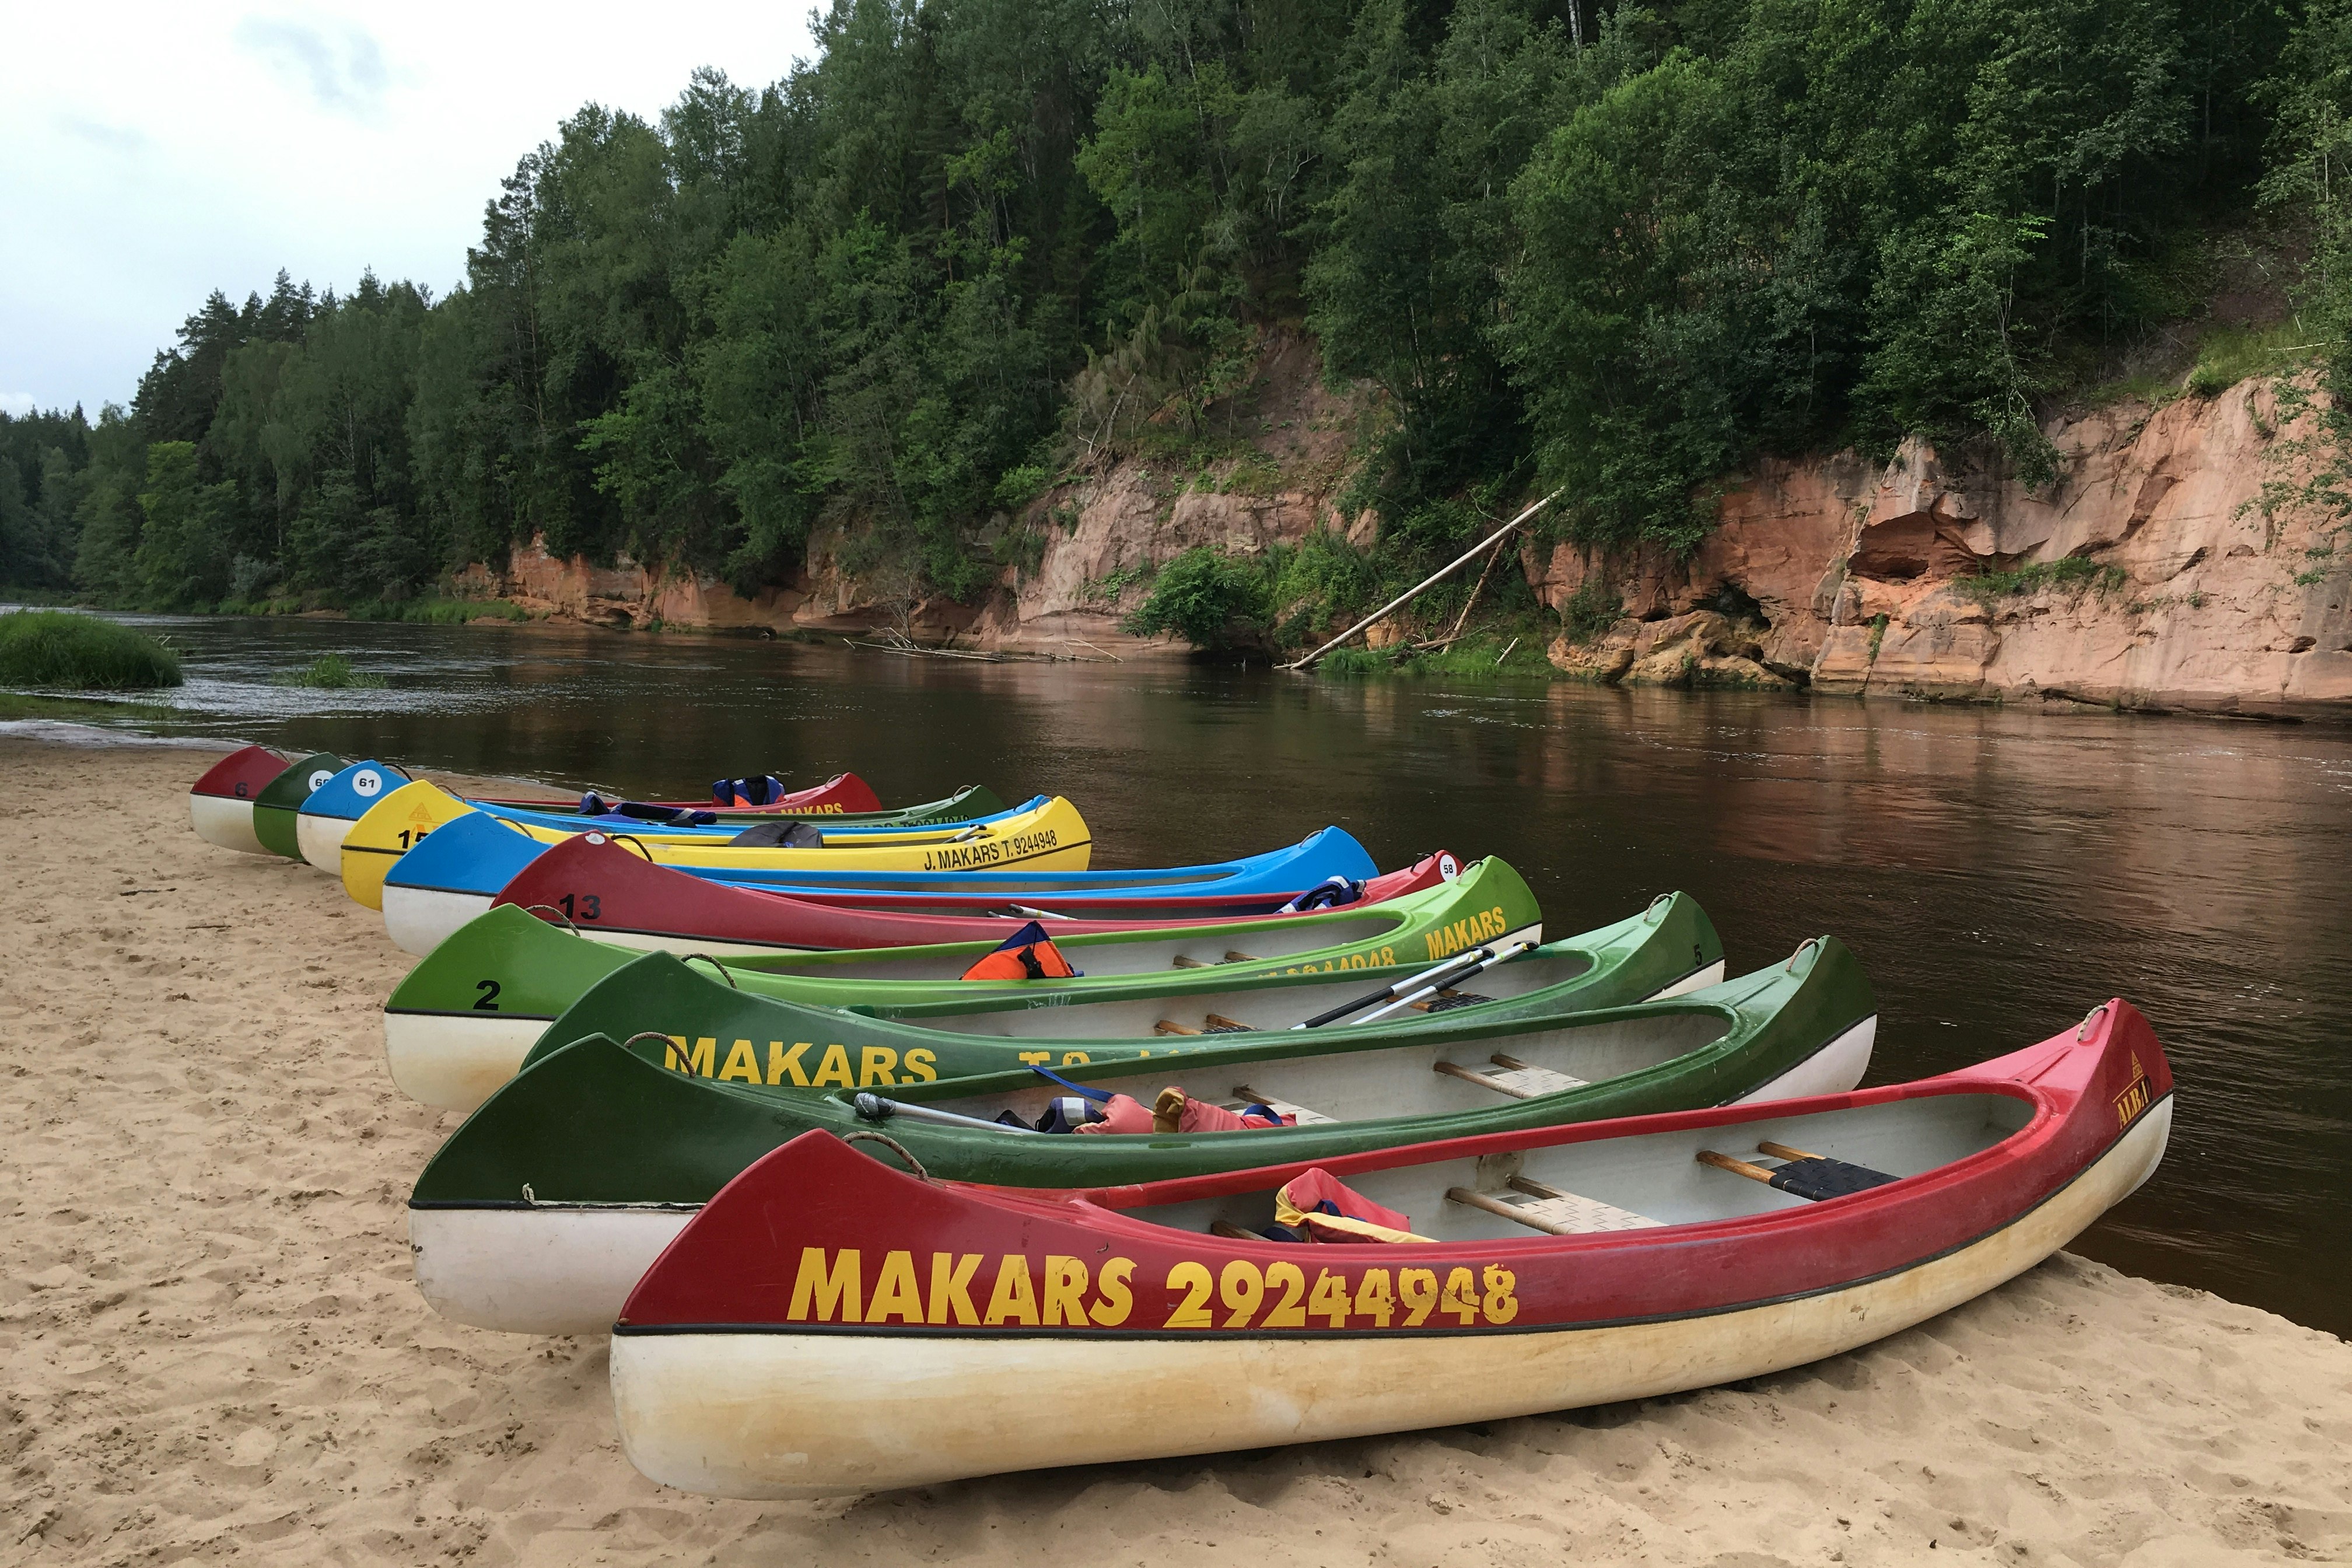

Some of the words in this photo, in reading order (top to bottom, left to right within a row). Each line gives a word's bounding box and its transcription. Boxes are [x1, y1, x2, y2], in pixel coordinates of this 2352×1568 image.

[235, 782, 248, 797] 6
[359, 778, 375, 788] 61
[925, 851, 936, 870] J.
[937, 842, 1000, 869] MAKARS
[1001, 839, 1013, 858] T.
[1014, 829, 1057, 855] 9244948
[1443, 864, 1454, 874] 58
[559, 893, 601, 919] 13
[1424, 906, 1506, 961] MAKARS
[1693, 943, 1703, 966] 5
[473, 980, 501, 1011] 2
[664, 1035, 937, 1088] MAKARS
[786, 1247, 1138, 1327] MAKARS
[1161, 1259, 1518, 1328] 29244948
